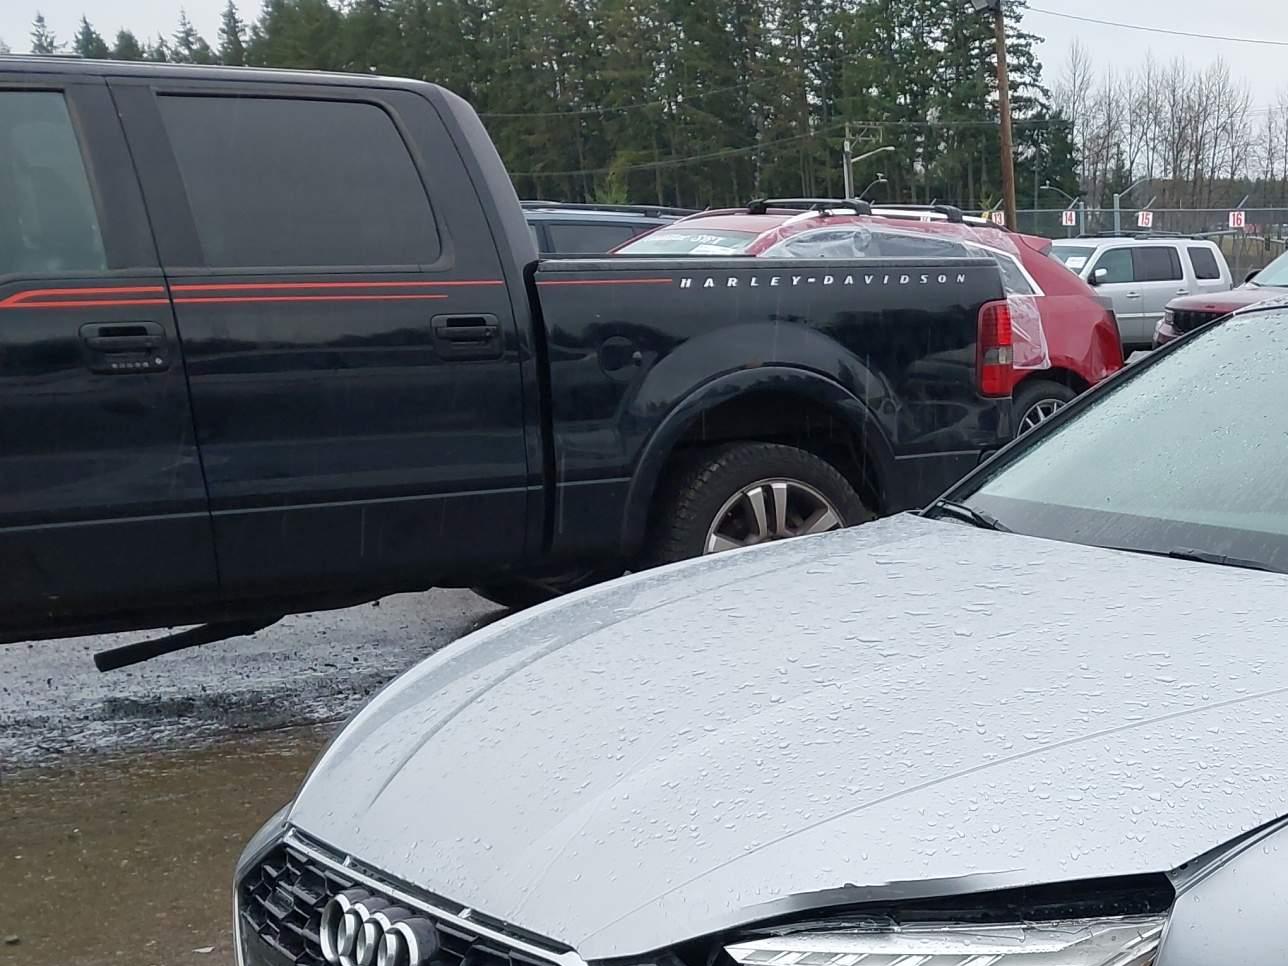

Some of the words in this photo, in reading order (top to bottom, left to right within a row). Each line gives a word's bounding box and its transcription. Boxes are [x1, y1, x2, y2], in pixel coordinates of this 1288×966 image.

[993, 212, 1003, 224] 13
[1063, 212, 1074, 225] 14
[1140, 213, 1151, 225] 15
[1231, 213, 1242, 225] 16
[680, 273, 967, 288] HARLEY-DAVIDSON
